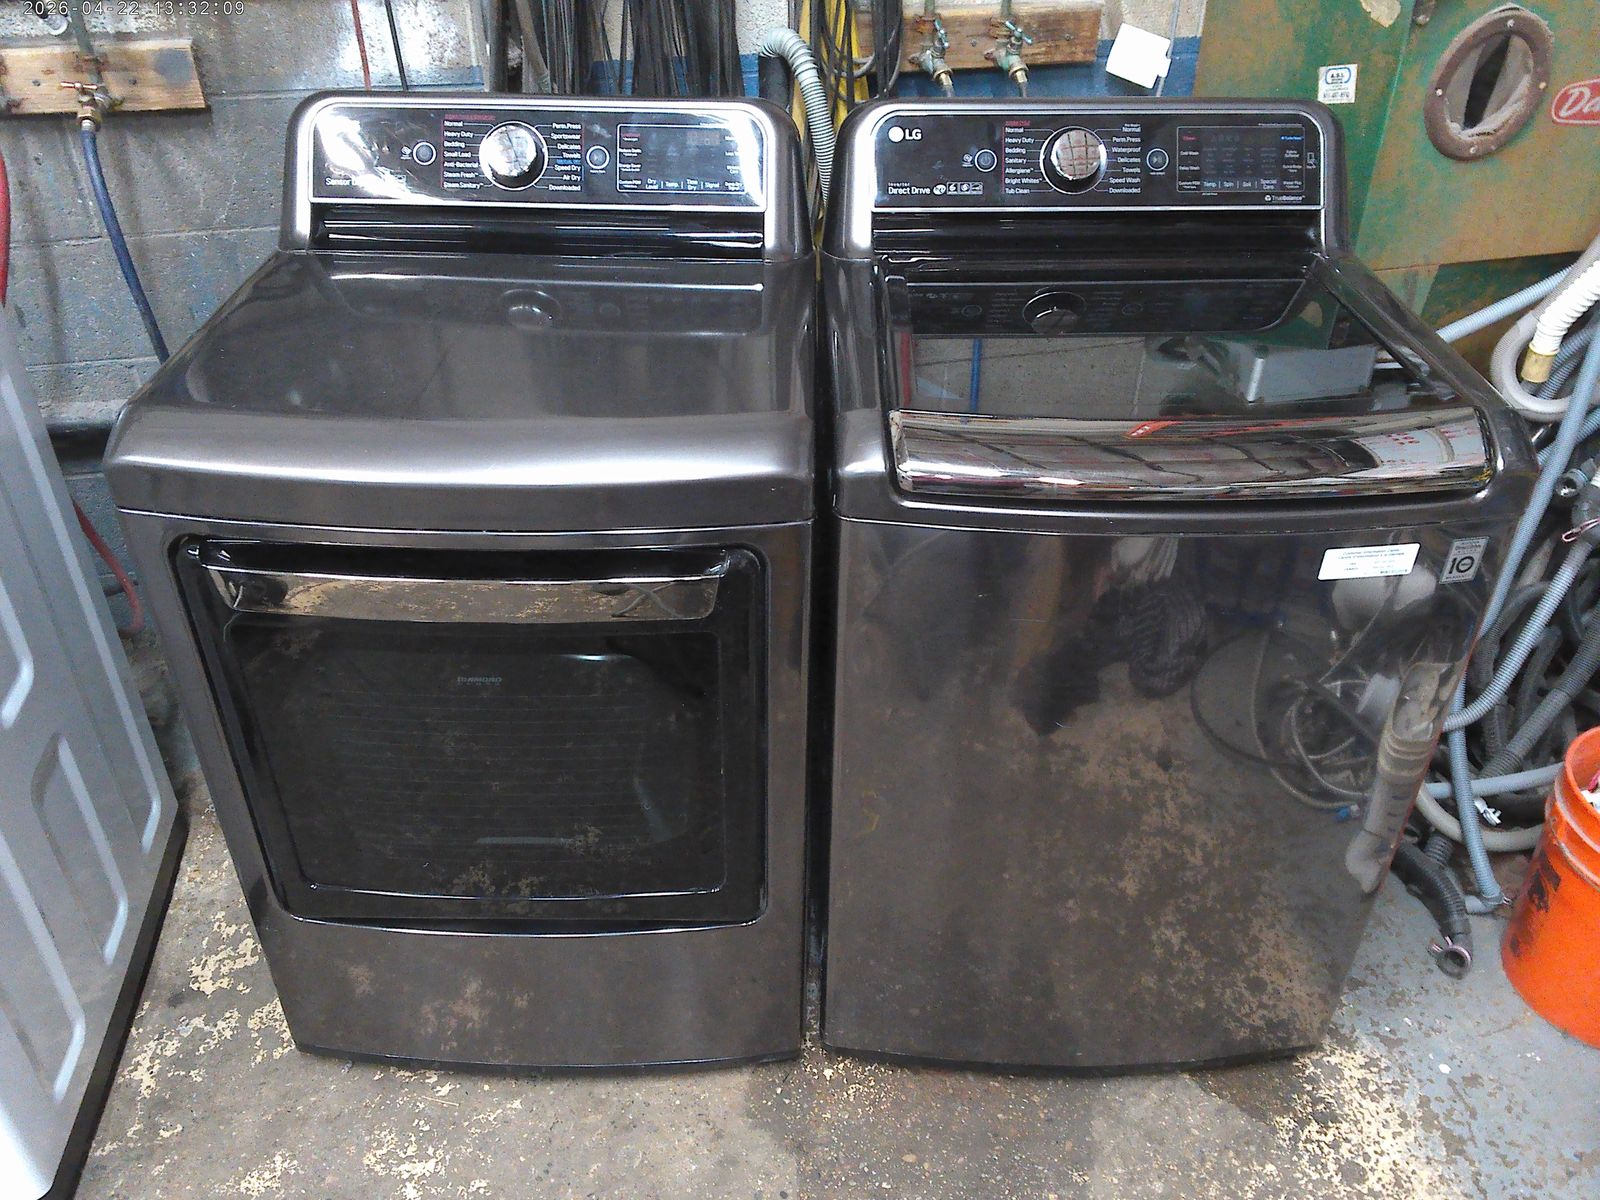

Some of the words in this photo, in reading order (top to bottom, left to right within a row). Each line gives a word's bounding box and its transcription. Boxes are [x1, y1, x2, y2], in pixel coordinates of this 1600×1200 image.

[905, 129, 922, 140] LG
[326, 178, 351, 186] Sensor
[1449, 556, 1474, 574] 10
